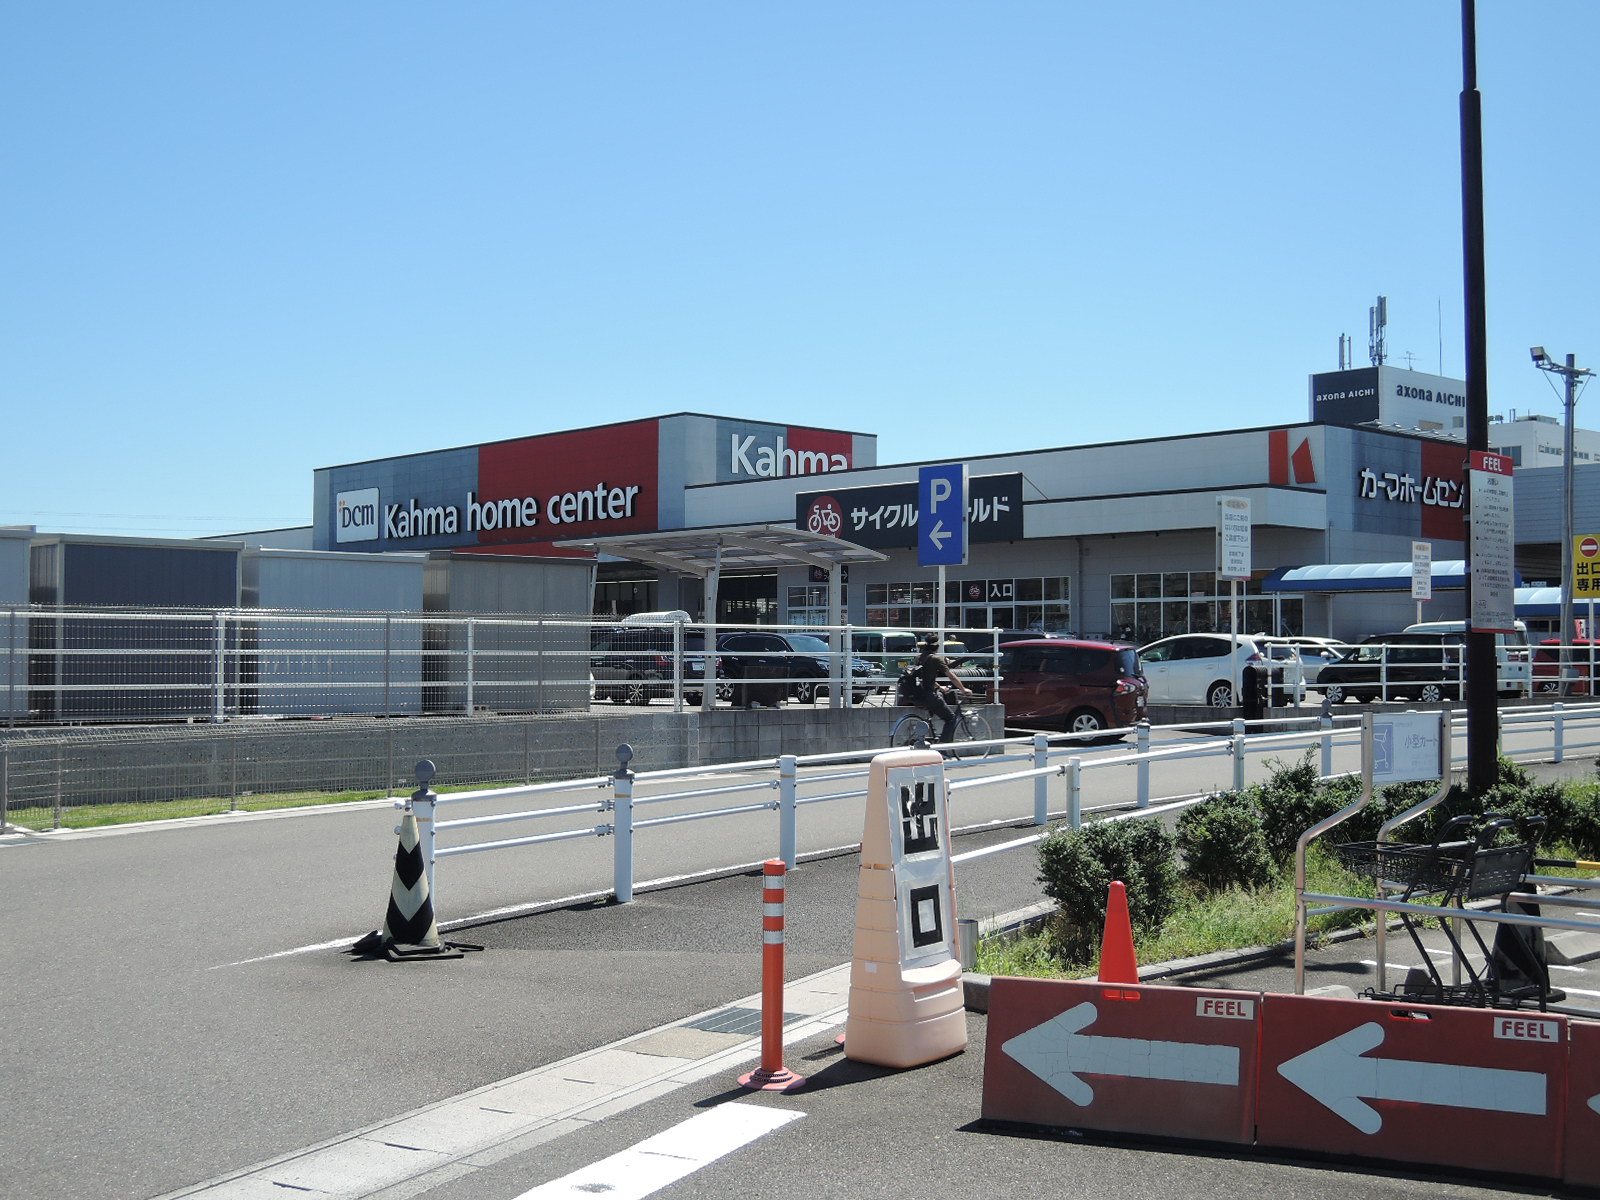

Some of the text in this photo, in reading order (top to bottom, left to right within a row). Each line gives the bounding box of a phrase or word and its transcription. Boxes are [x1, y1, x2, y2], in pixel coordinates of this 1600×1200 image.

[1316, 388, 1375, 402] axona AICHI
[1396, 384, 1465, 408] axona AICHI
[731, 433, 848, 477] Kahma
[1482, 456, 1503, 472] FEEL
[930, 478, 952, 515] P
[1361, 467, 1465, 508] カーマホームセン
[384, 482, 639, 539] Kahma home center
[851, 496, 1010, 531] サイクルルド
[989, 583, 1013, 597] 入口
[1202, 1000, 1247, 1017] FEEL
[1501, 1019, 1551, 1040] FEEL
